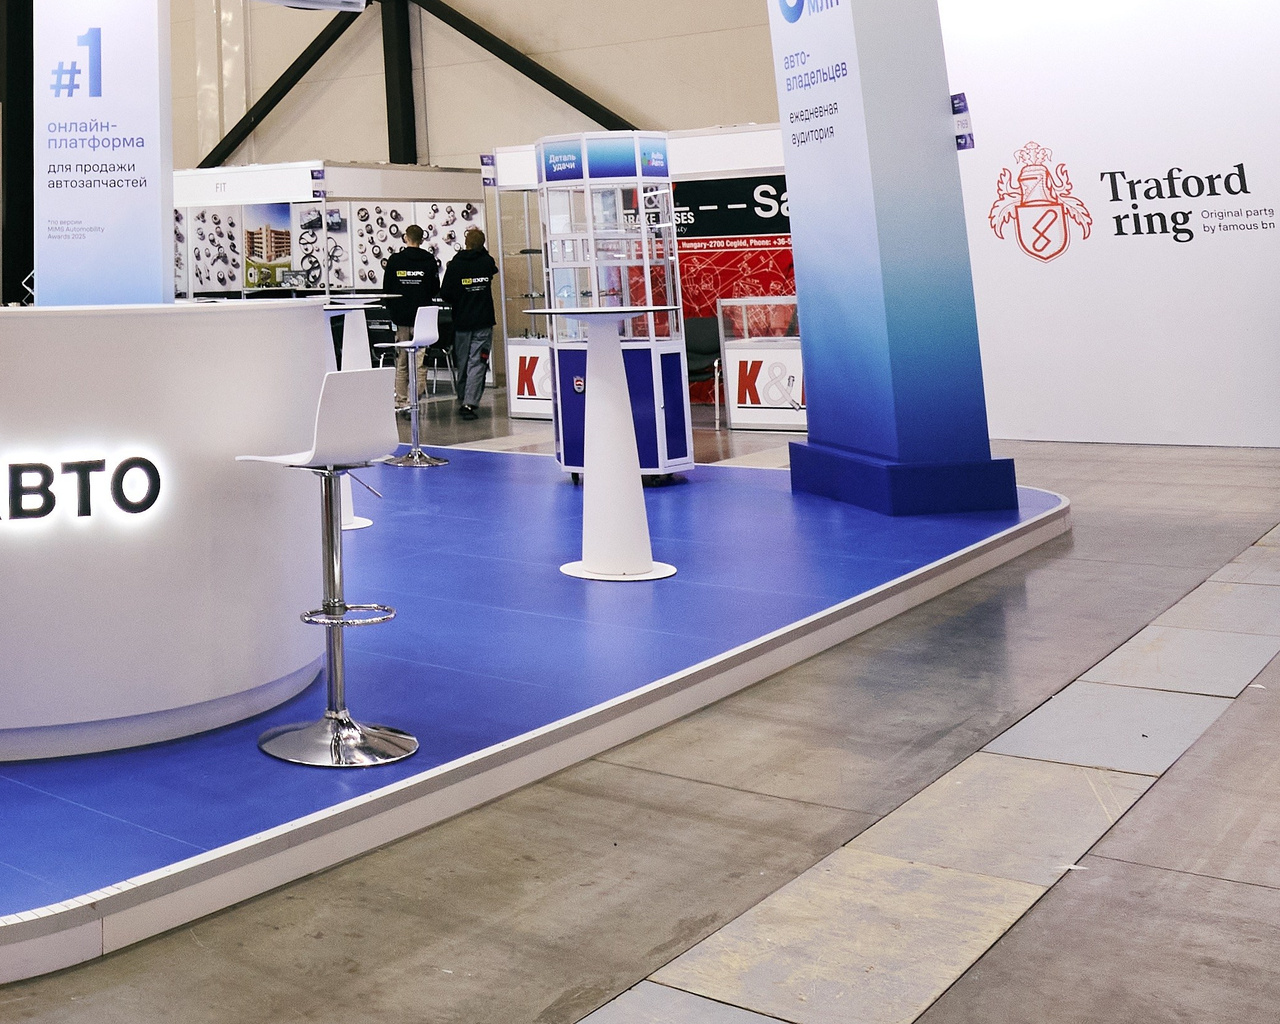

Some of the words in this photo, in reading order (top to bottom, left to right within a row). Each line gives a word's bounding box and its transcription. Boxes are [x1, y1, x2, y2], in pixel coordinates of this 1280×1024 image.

[50, 27, 102, 98] #1
[784, 50, 810, 70] авто-
[786, 62, 847, 91] владельцев
[789, 102, 838, 124] ежедневная
[48, 119, 117, 132] онлайн-
[48, 135, 145, 151] платформа
[791, 126, 834, 148] аудитория
[48, 163, 72, 175] для
[75, 163, 136, 175] продажи
[48, 176, 147, 188] автозапчастей
[1100, 163, 1251, 202] Traford
[1112, 204, 1194, 243] ring
[1201, 209, 1243, 220] Original
[1203, 224, 1215, 233] by
[1218, 222, 1258, 232] famous
[737, 360, 805, 411] K&
